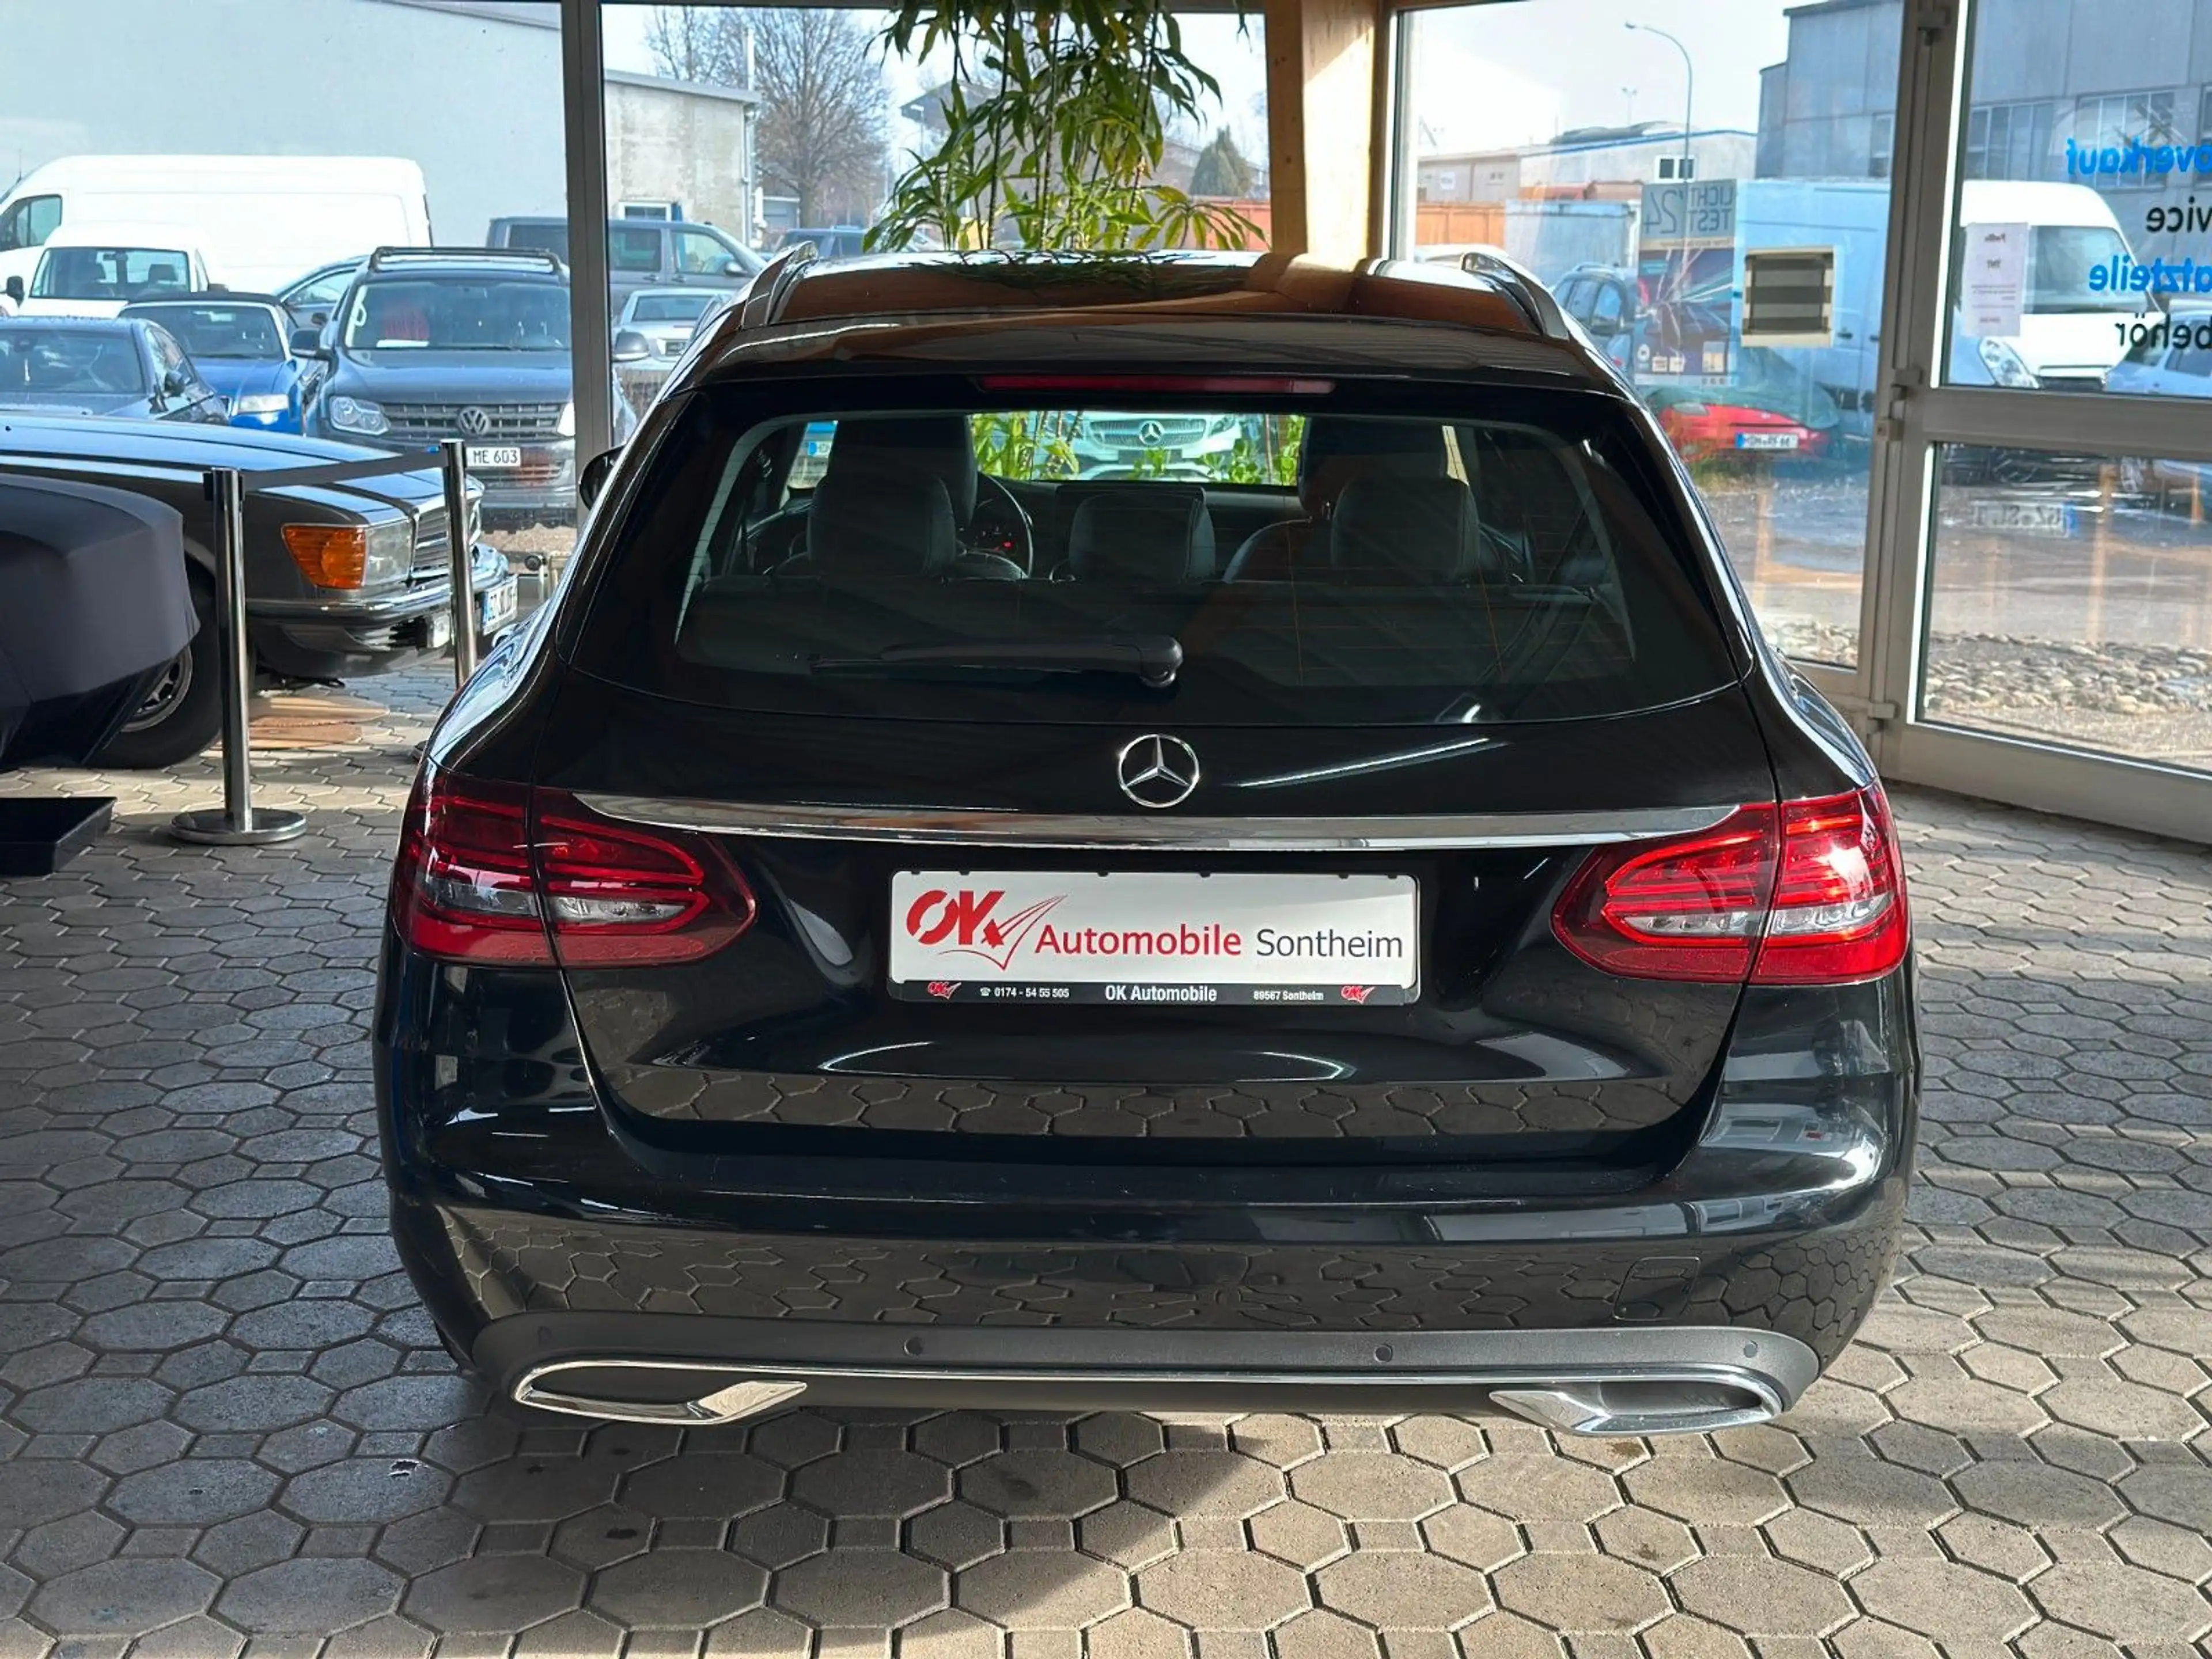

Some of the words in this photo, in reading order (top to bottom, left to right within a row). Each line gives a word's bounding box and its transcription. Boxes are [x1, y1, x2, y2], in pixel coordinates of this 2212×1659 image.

[473, 450, 490, 464] ME
[494, 450, 518, 464] 603
[906, 889, 1006, 948] OK
[1035, 923, 1241, 955] Automobile
[1256, 929, 1403, 958] Sontheim
[994, 987, 1017, 997] 0174
[1025, 987, 1037, 997] 54
[1039, 988, 1050, 998] 55
[1052, 988, 1070, 998] 505
[1105, 984, 1127, 1001] OK
[1130, 986, 1217, 1002] Automobile
[1282, 991, 1324, 1001] Sontheim
